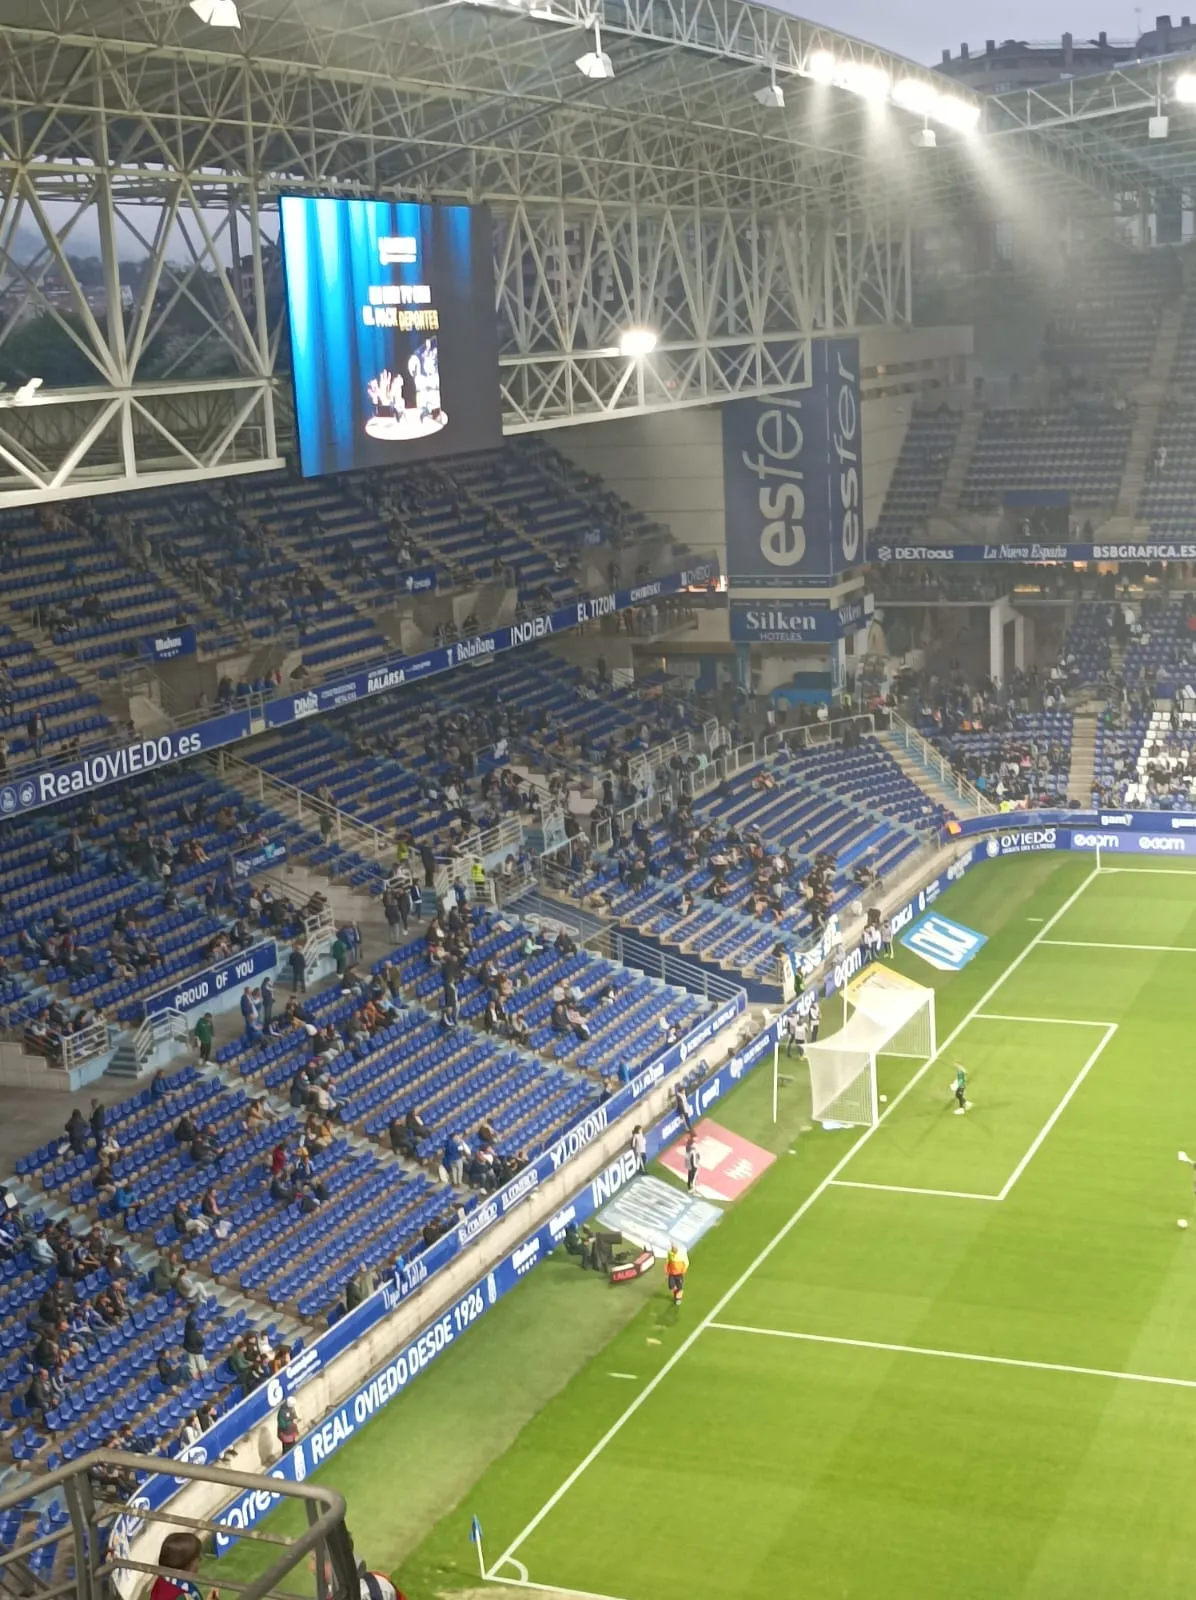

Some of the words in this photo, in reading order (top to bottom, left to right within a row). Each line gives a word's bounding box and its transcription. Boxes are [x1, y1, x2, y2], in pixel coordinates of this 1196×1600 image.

[833, 351, 859, 561] esfer
[983, 545, 997, 559] La
[577, 604, 587, 623] EL
[746, 611, 817, 630] Silken
[510, 616, 553, 646] INDIBA
[760, 632, 802, 641] HOTELES
[367, 669, 405, 693] RALARSA
[39, 732, 202, 801] RealOVIEDO.es
[1001, 830, 1057, 848] OVIEDO
[175, 982, 209, 1010] PROUD
[216, 972, 228, 989] OF
[235, 959, 254, 979] YOU
[311, 1410, 354, 1464] REAL
[354, 1358, 408, 1422] OVIEDO
[408, 1315, 454, 1376] DESDE
[454, 1288, 484, 1332] 1926
